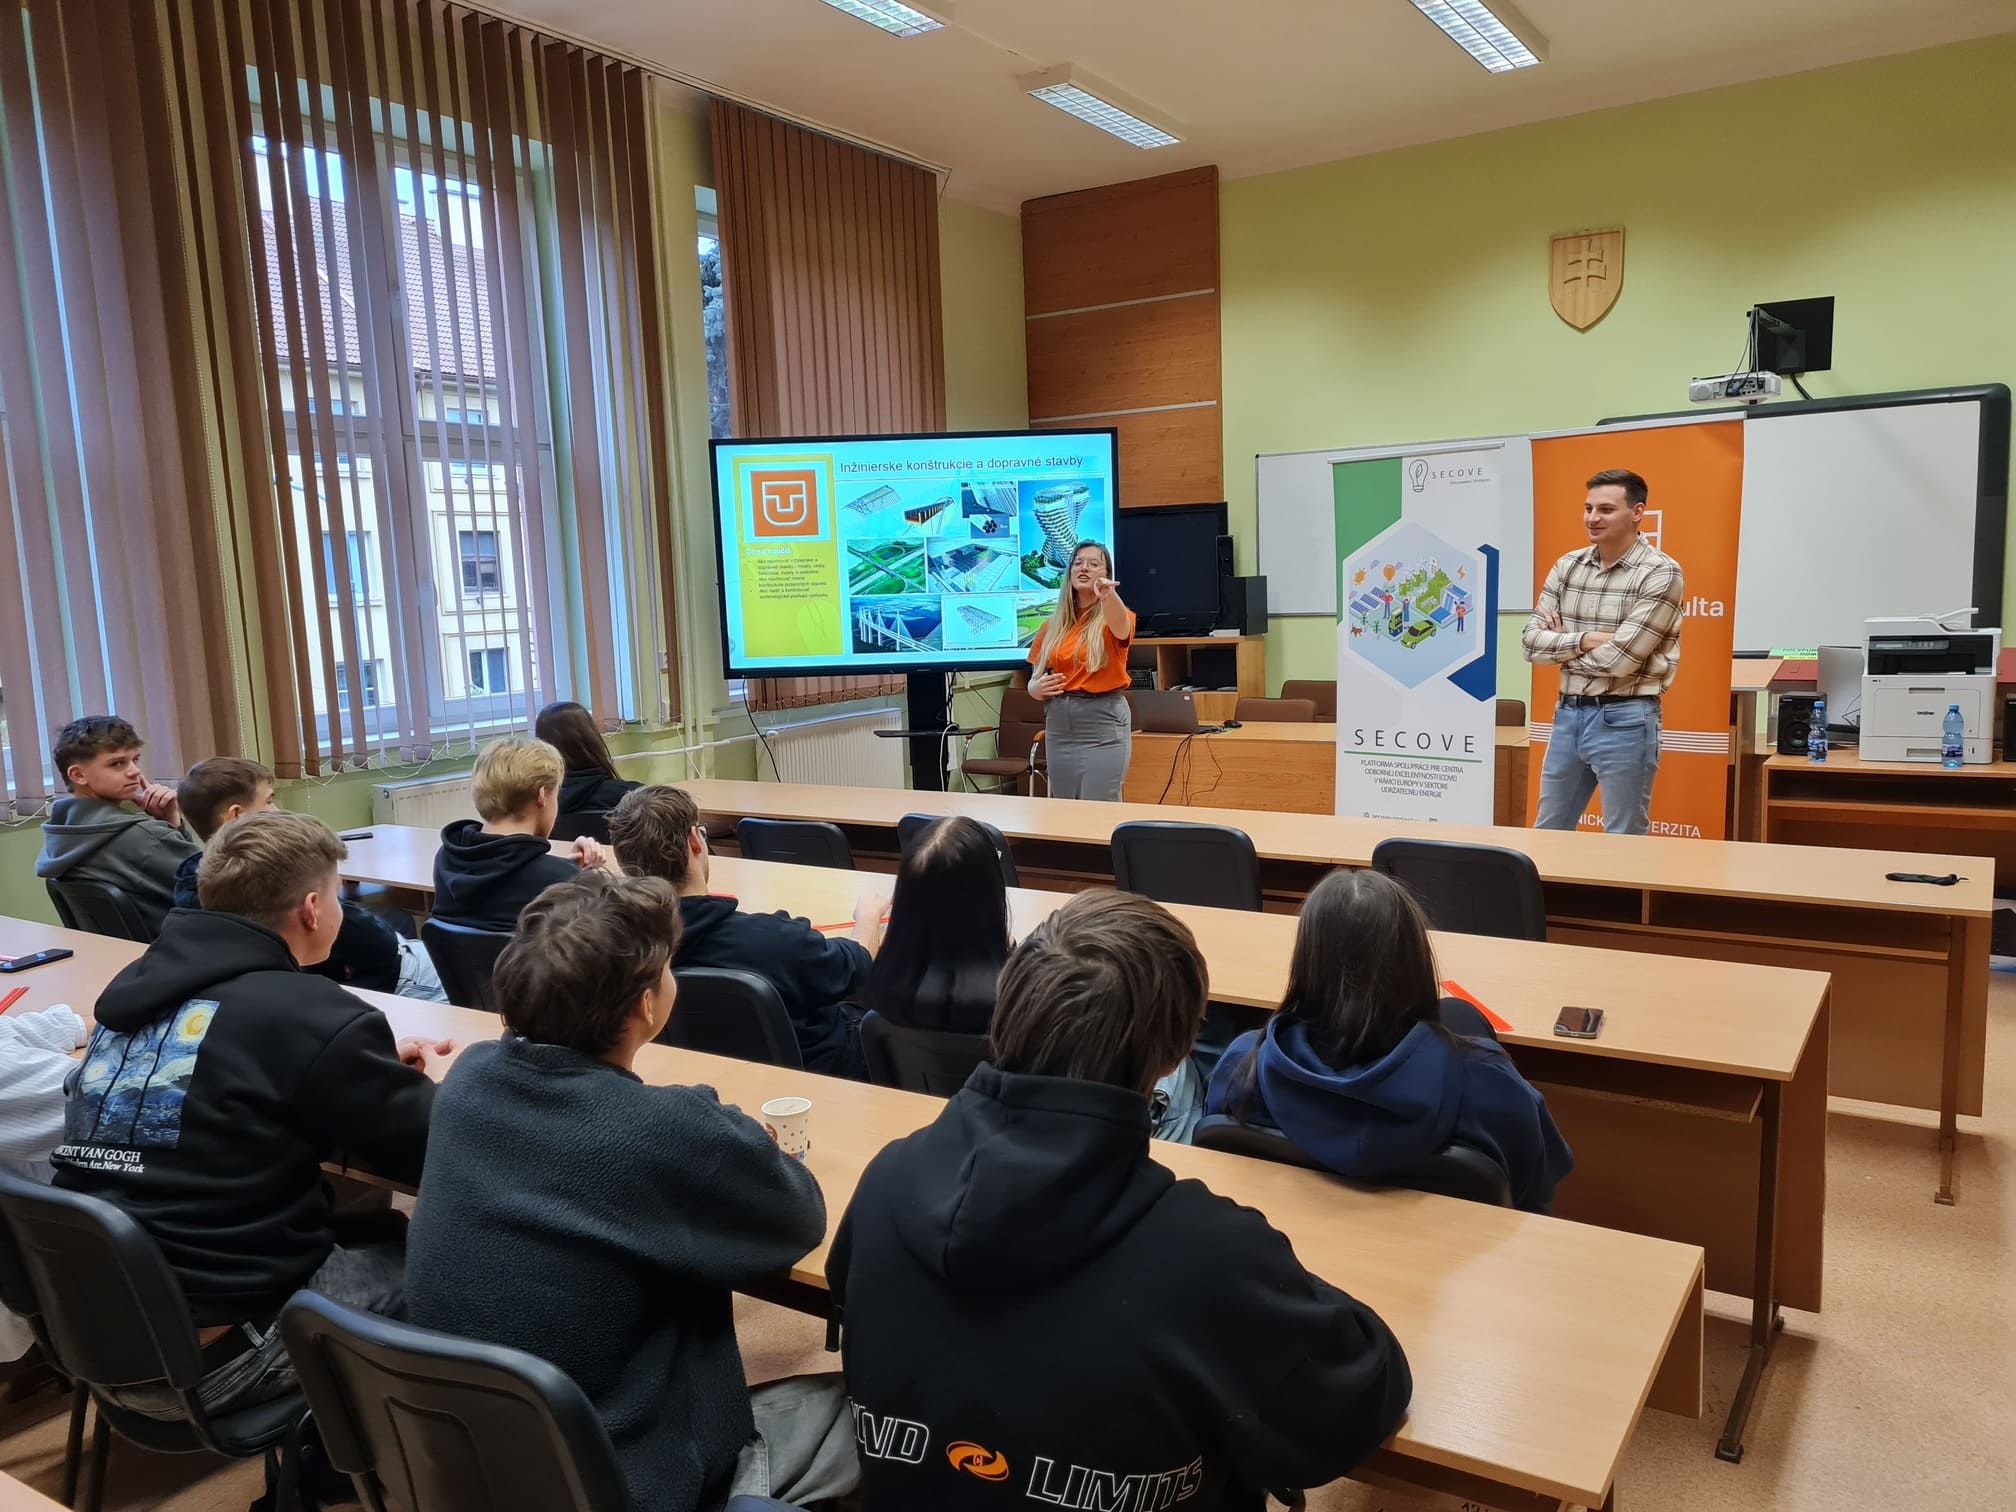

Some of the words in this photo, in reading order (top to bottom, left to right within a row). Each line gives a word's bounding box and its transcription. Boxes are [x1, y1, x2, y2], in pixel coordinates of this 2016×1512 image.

[840, 461, 903, 473] Inžinierske
[906, 458, 973, 471] konštrukcie
[976, 460, 984, 469] a
[987, 455, 1042, 470] dopravné
[1045, 455, 1084, 468] stavby
[1431, 467, 1484, 480] SECOVE
[1682, 596, 1724, 617] ulta
[1354, 729, 1475, 753] SECOVE
[1360, 759, 1394, 769] PLATFORMA
[1430, 764, 1441, 772] PRE
[1364, 768, 1394, 777] ODBORNEJ
[1394, 770, 1439, 780] EXCELENTNOSTI
[1424, 781, 1449, 790] SEKTORE
[1419, 789, 1442, 798] ENERGIE
[1578, 813, 1605, 827] NICK
[1649, 820, 1701, 838] ERZITA
[80, 1147, 105, 1159] VAN
[104, 1149, 142, 1163] GOGH
[122, 1163, 145, 1173] York
[1025, 1455, 1202, 1512] LIMITS
